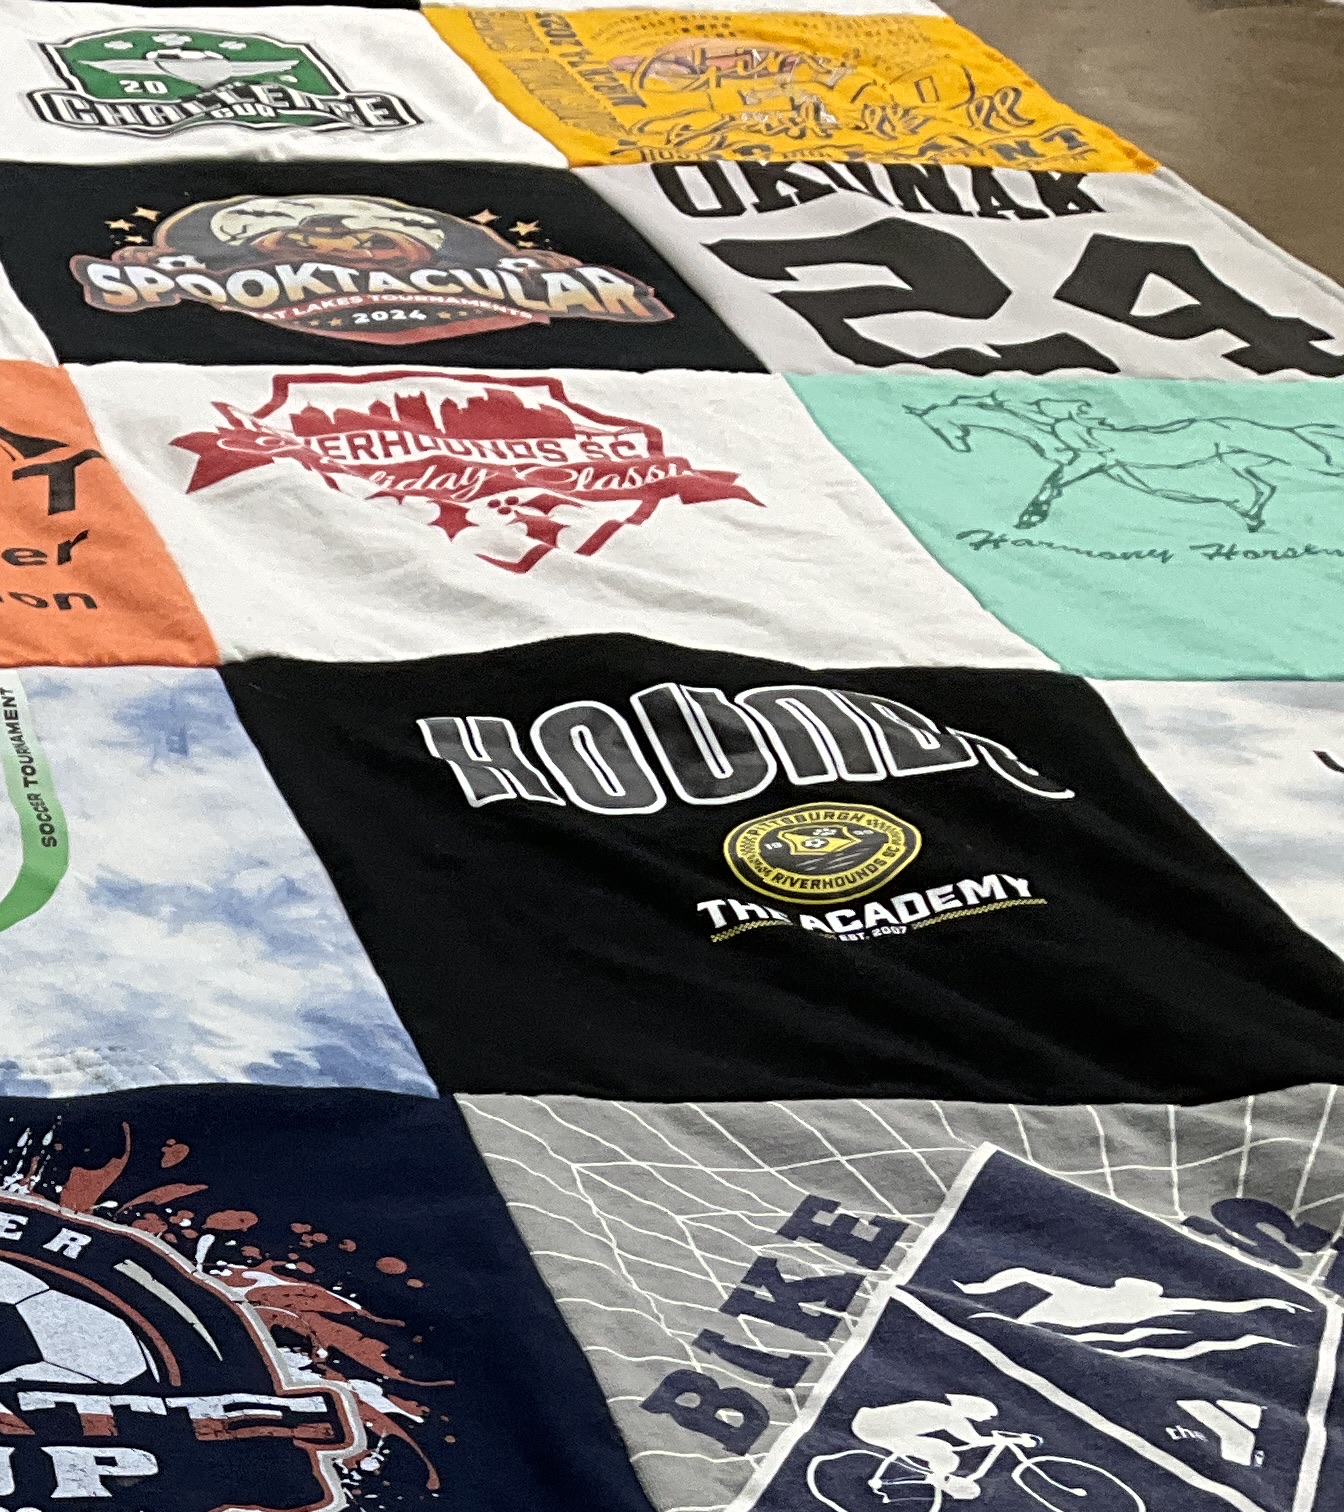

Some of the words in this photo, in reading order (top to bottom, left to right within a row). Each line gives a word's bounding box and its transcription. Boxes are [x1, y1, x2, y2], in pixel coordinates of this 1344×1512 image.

[84, 262, 650, 316] SPOOKTACULAR
[290, 293, 365, 317] LAKES
[701, 216, 1344, 379] 24
[350, 308, 428, 325] 2024
[955, 529, 1176, 564] Harmony
[29, 791, 58, 849] SOCCER
[749, 811, 866, 840] PITTSBURGH
[771, 859, 889, 890] RIVERHOUNDS
[697, 898, 794, 930] THE
[799, 873, 1034, 935] ACADEMY
[838, 932, 871, 943] EST.
[872, 926, 908, 938] 2007
[639, 1192, 911, 1457] BIKE
[1164, 1424, 1210, 1444] the
